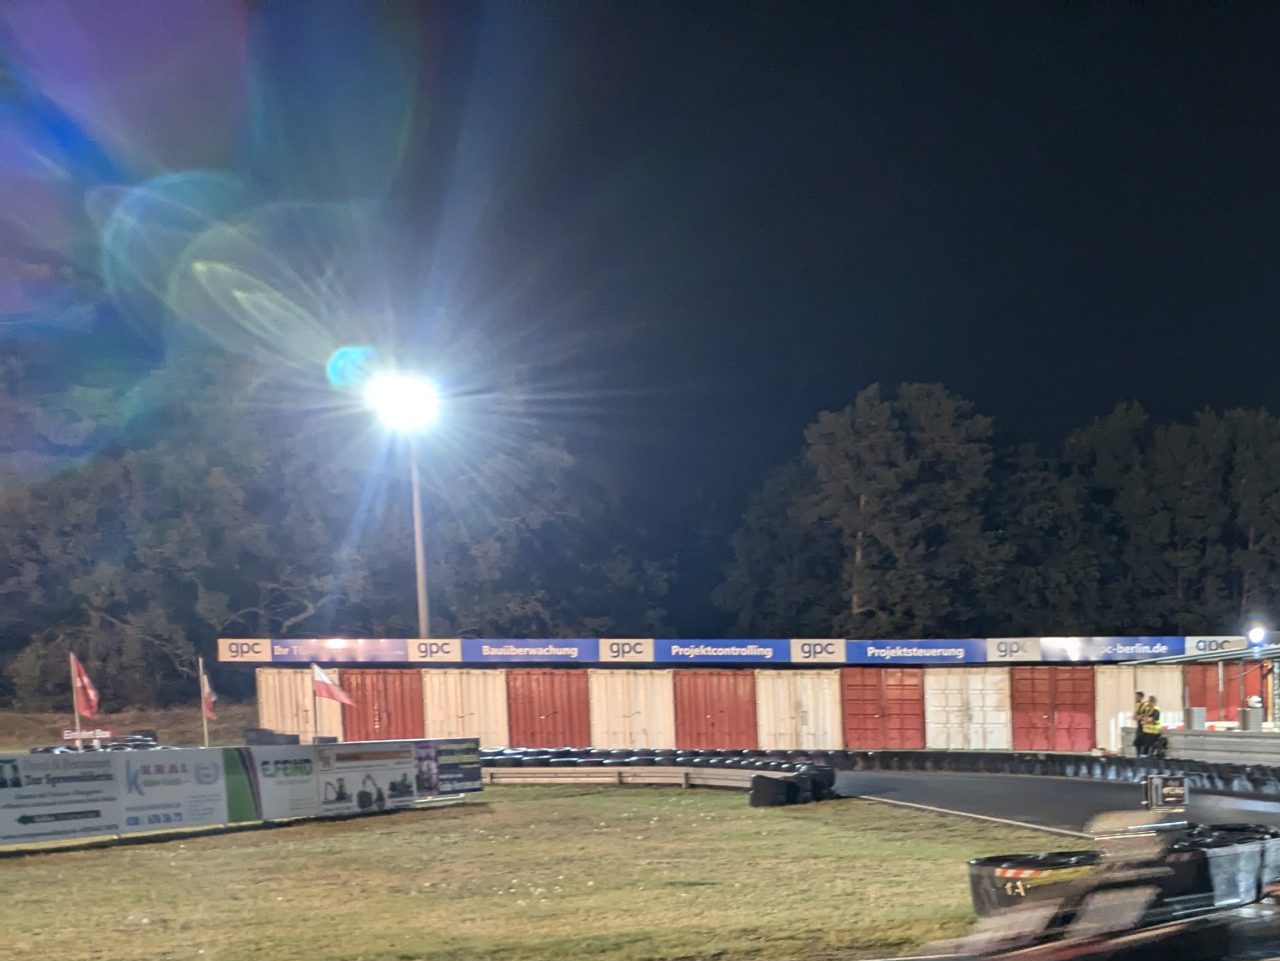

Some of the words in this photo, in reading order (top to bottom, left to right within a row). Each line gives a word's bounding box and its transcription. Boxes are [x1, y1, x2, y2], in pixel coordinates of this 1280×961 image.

[228, 642, 262, 658] gpc
[417, 641, 451, 658] gpc
[482, 644, 578, 658] Bauüberwachung
[609, 641, 643, 658] gpc
[671, 644, 773, 658] Projektcontrolling
[800, 640, 835, 658] gpc
[867, 646, 965, 659] Projektsteuerung
